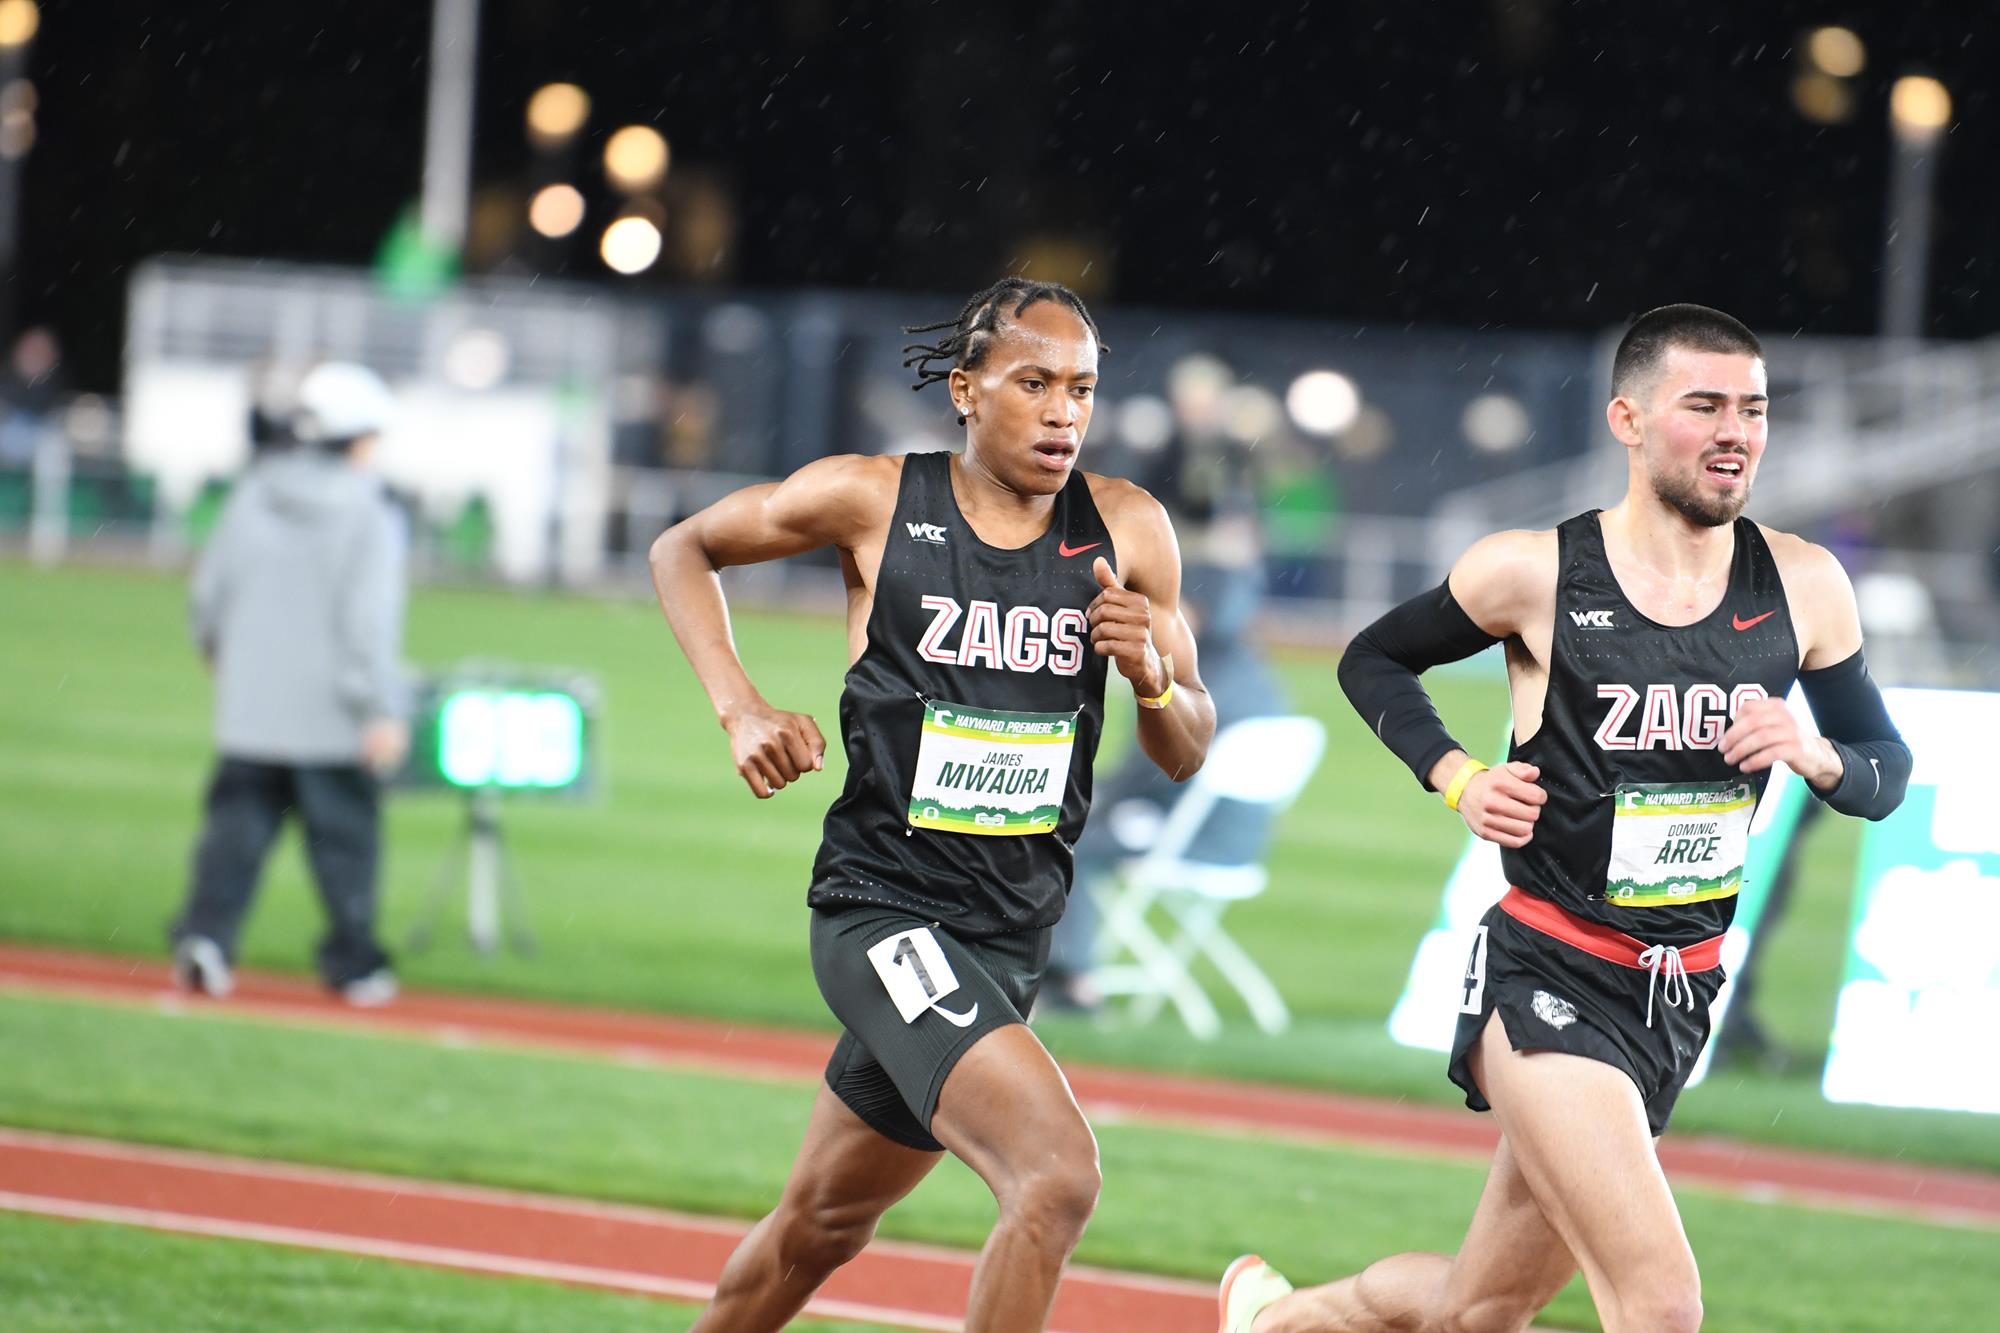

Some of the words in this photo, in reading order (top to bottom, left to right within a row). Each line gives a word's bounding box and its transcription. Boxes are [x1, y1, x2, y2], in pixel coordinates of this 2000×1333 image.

[906, 522, 947, 542] WCC
[1569, 611, 1614, 627] WCC
[917, 595, 1087, 676] ZAGS
[954, 714, 1004, 732] HAYWARD
[1006, 721, 1055, 734] PREMIERE
[982, 752, 1023, 766] JAMES
[936, 761, 1049, 795] MWAURA
[1645, 793, 1692, 805] HAYWARD
[1695, 787, 1737, 804] PREMIERE
[1668, 822, 1717, 836] DOMINIC
[1654, 837, 1721, 864] ARCE
[893, 936, 938, 999] 1
[1464, 933, 1481, 1005] 4
